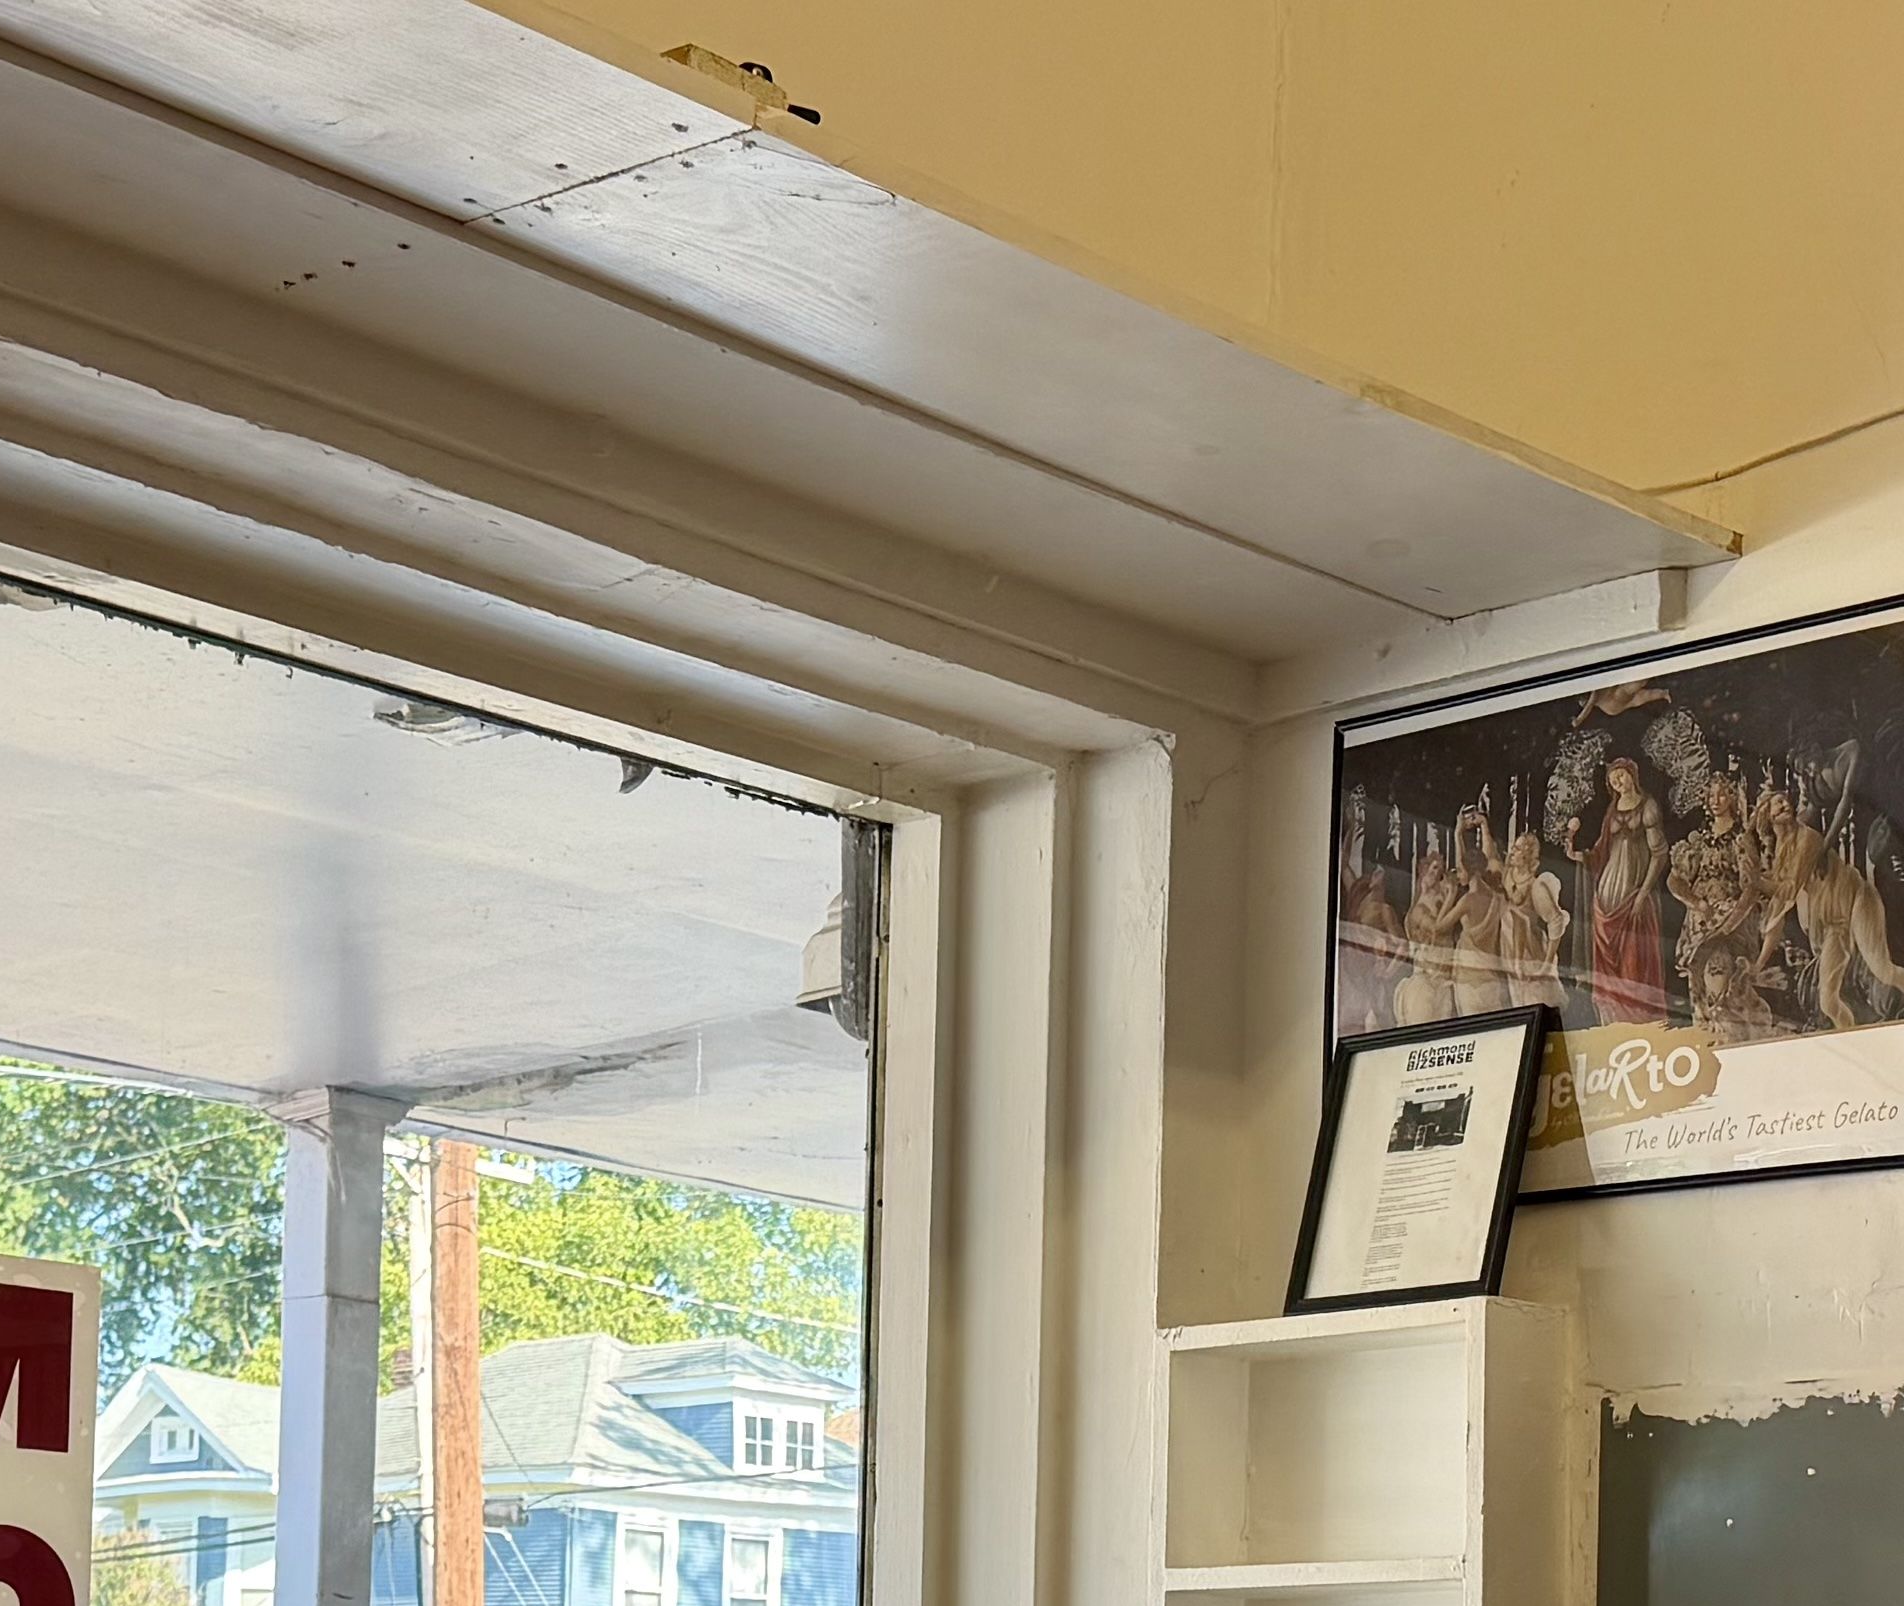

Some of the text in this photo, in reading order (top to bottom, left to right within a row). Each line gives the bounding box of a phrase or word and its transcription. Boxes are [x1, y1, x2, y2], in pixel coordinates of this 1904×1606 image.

[1623, 1130, 1658, 1153] The
[1667, 1116, 1739, 1149] World's
[1746, 1109, 1826, 1139] Tastiest
[1833, 1100, 1899, 1129] Gelato
